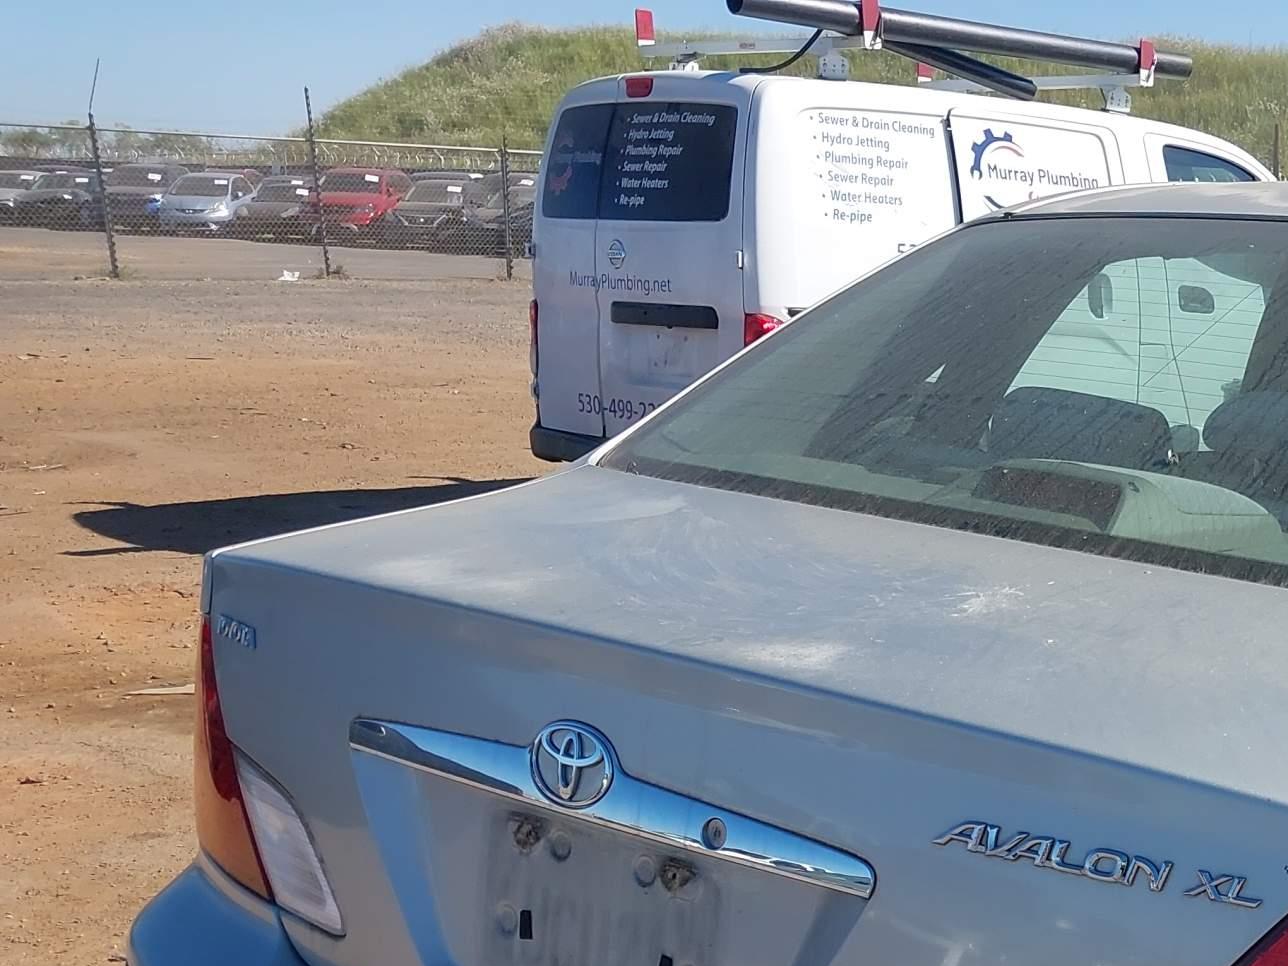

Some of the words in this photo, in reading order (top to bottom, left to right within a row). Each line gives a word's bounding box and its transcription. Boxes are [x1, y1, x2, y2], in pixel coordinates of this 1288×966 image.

[632, 113, 652, 124] Sewer
[652, 112, 659, 123] &
[659, 112, 680, 123] Drain
[681, 112, 716, 127] Cleaning
[818, 112, 849, 126] Sewer
[851, 115, 859, 127] &
[862, 117, 890, 131] Drain
[892, 120, 935, 138] Cleaning
[628, 128, 649, 142] Hydro
[649, 127, 675, 142] Jetting
[822, 132, 853, 147] Hydro
[856, 135, 890, 152] Jetting
[625, 144, 658, 158] Plumbing
[658, 144, 684, 158] Repair
[622, 160, 643, 172] Sewer
[643, 160, 668, 174] Repair
[824, 151, 874, 169] Plumbing
[876, 155, 908, 170] Repair
[827, 170, 859, 184] Sewer
[861, 172, 894, 187] Repair
[987, 162, 1034, 186] Murray
[621, 177, 641, 188] Water
[641, 177, 669, 189] Heaters
[619, 193, 645, 208] Re-pipe
[830, 189, 861, 202] Water
[864, 191, 903, 205] Heaters
[832, 208, 873, 224] Re-pipe
[569, 271, 672, 296] MurrayPlumbing.net
[930, 819, 1175, 893] AVALON
[1183, 868, 1264, 909] XL
